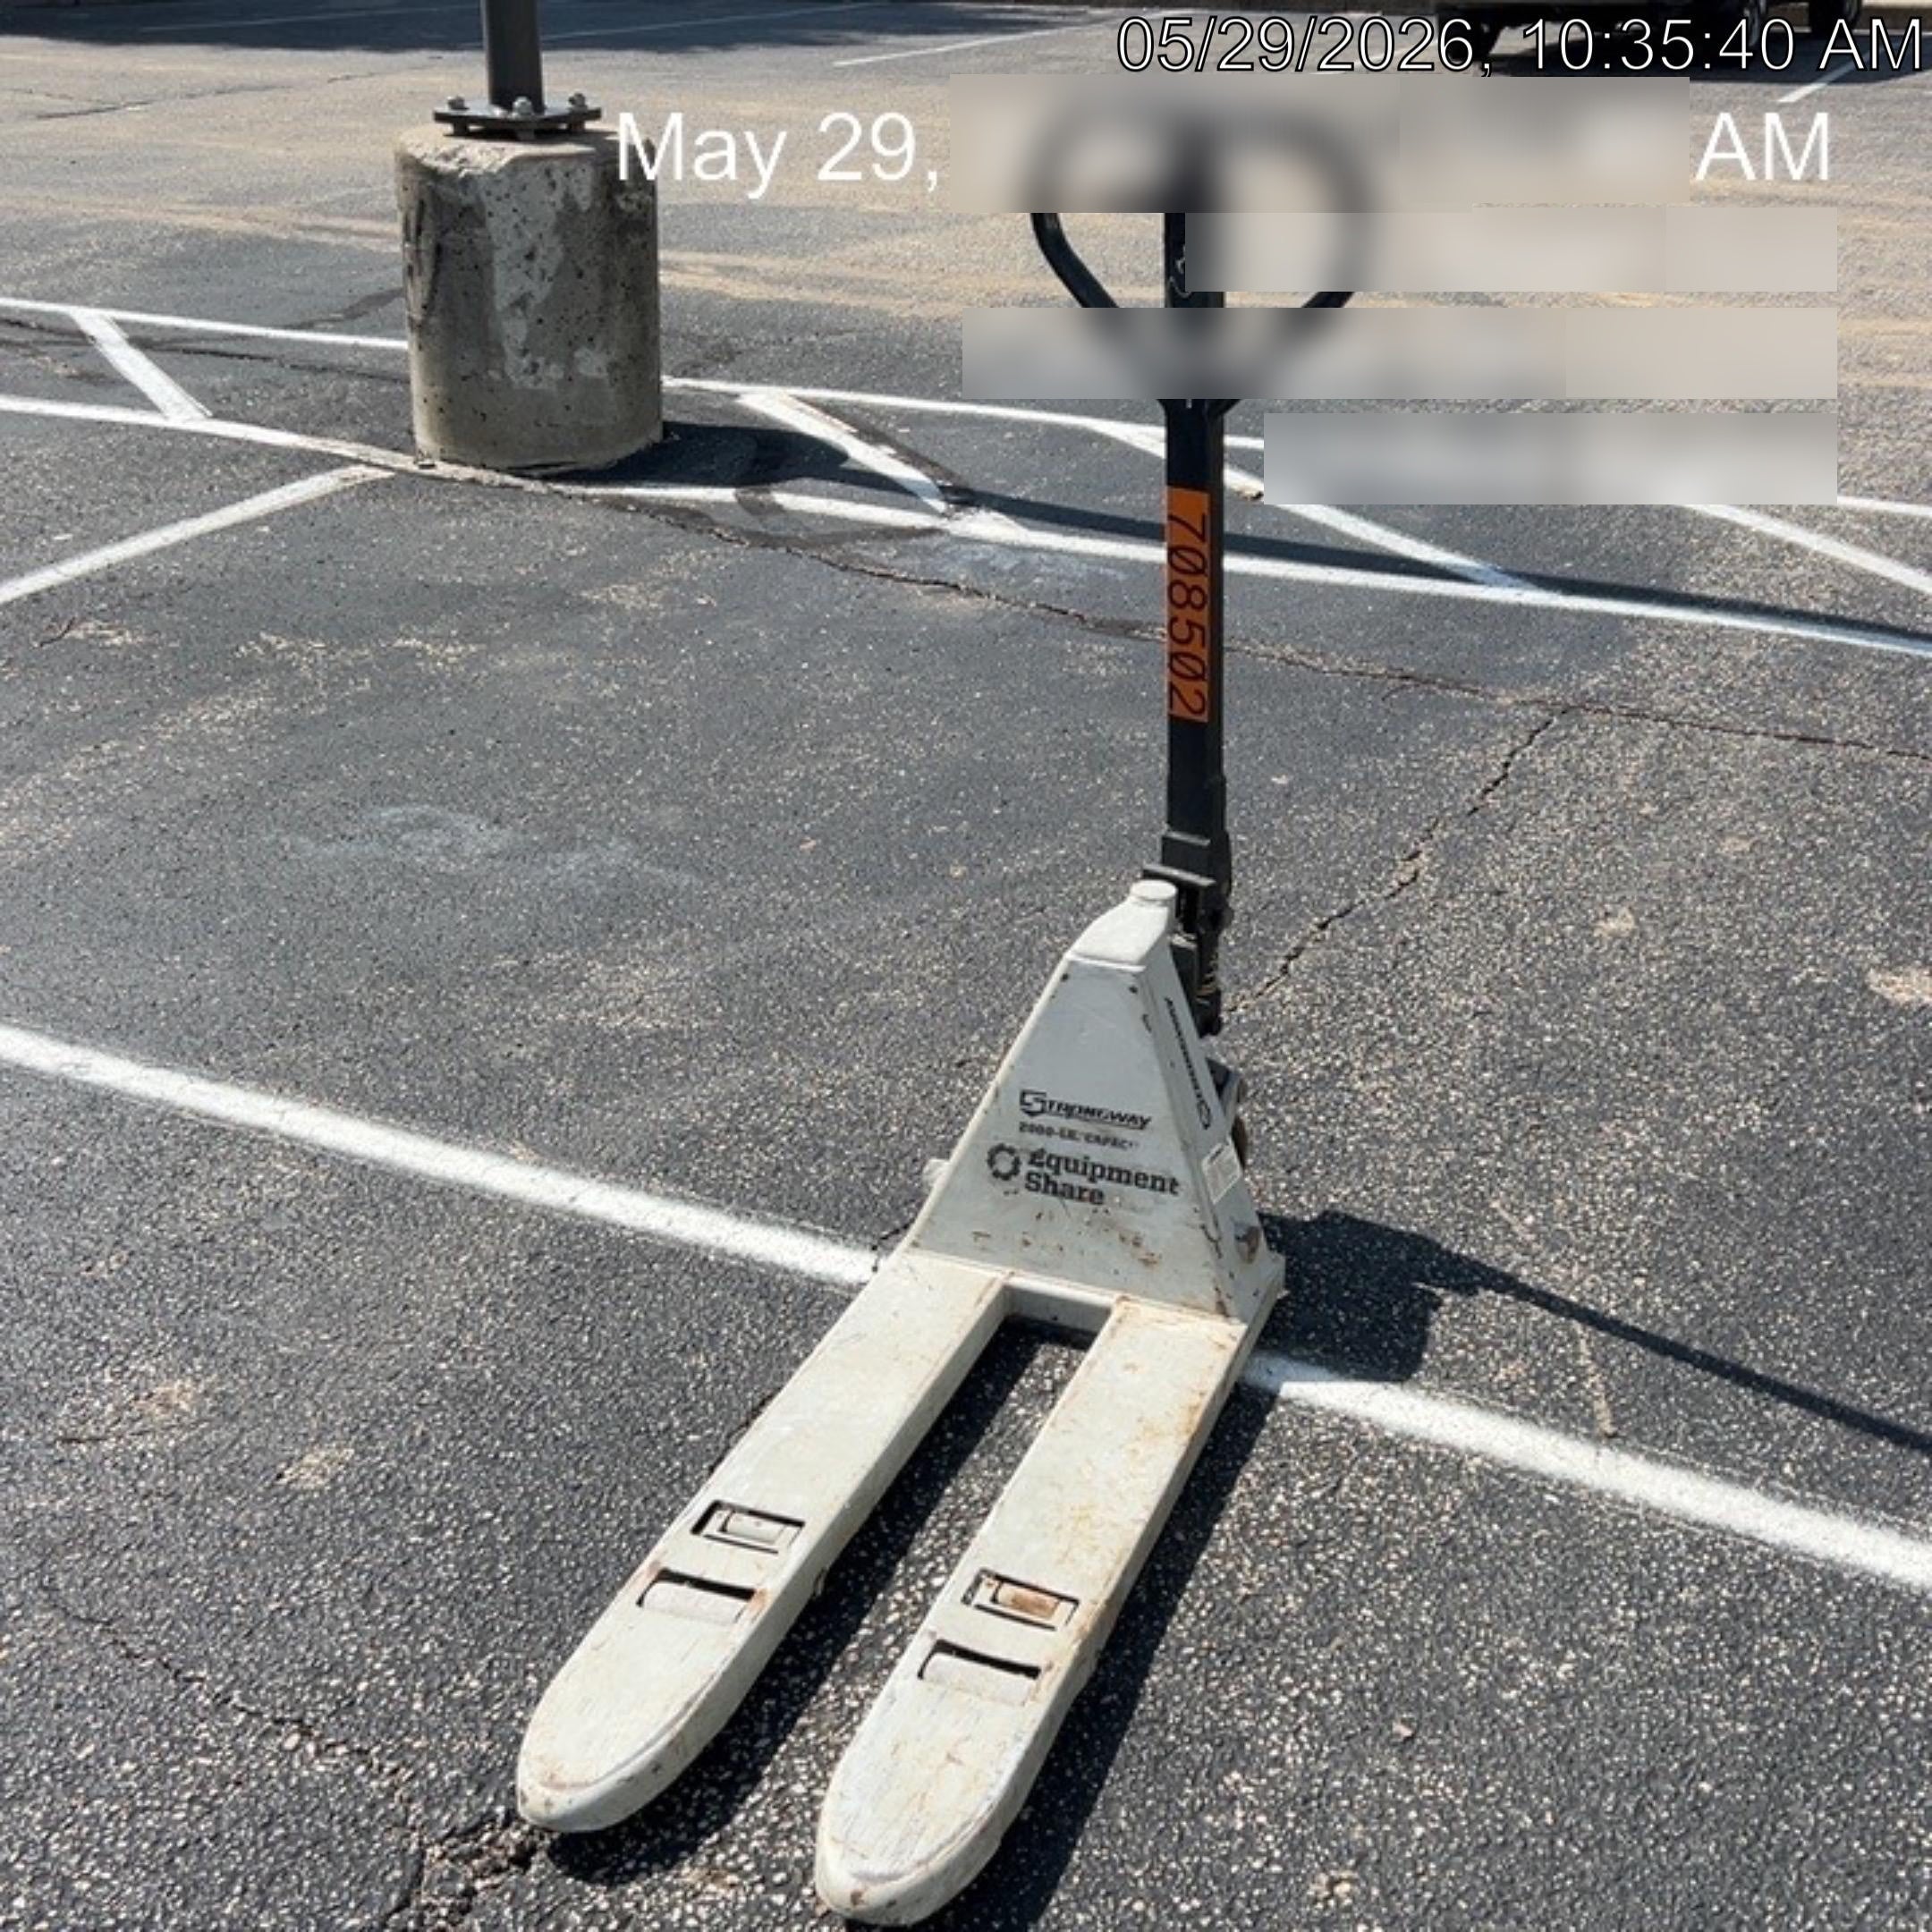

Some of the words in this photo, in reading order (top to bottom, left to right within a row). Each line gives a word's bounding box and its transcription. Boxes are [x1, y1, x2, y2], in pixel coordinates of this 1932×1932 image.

[1167, 513, 1208, 716] 708502
[1025, 1170, 1105, 1205] Share
[1029, 1148, 1180, 1195] Equipment
